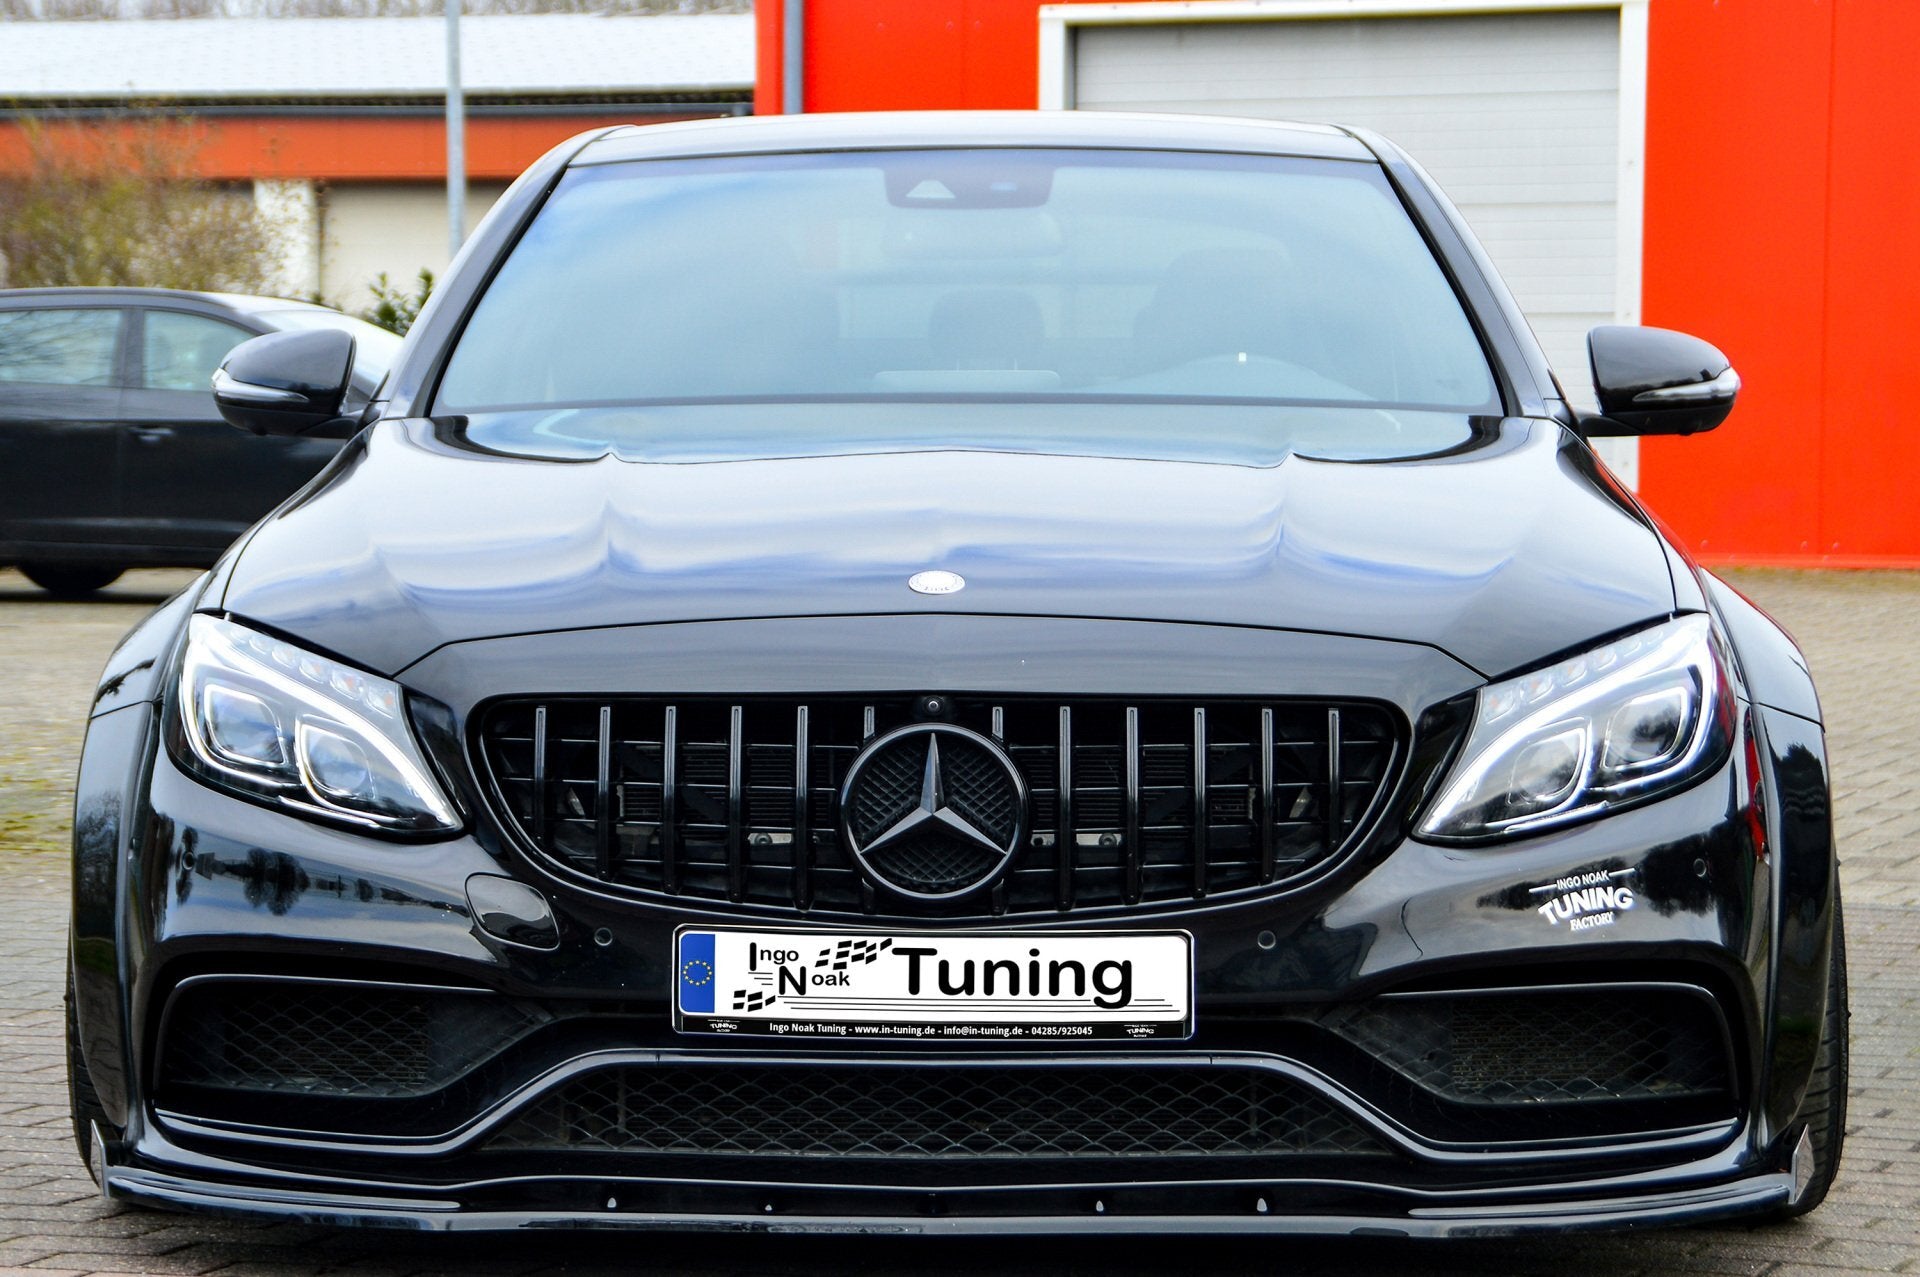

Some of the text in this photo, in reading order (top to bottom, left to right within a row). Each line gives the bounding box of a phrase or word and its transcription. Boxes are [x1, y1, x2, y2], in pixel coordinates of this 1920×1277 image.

[1556, 870, 1610, 890] INGO NOAK
[1538, 886, 1634, 925] TUNING
[1570, 911, 1614, 931] FACTORY
[748, 942, 800, 972] Ingo
[778, 965, 850, 996] Noak
[891, 947, 1132, 1009] Tuning
[769, 1022, 789, 1033] Ingo
[792, 1023, 815, 1032] Noak
[817, 1024, 847, 1035] Tuning
[855, 1025, 935, 1036] www.in-tuning.de
[943, 1025, 1023, 1037] info@in-tuning.de
[1031, 1027, 1093, 1036] 04285/925045
